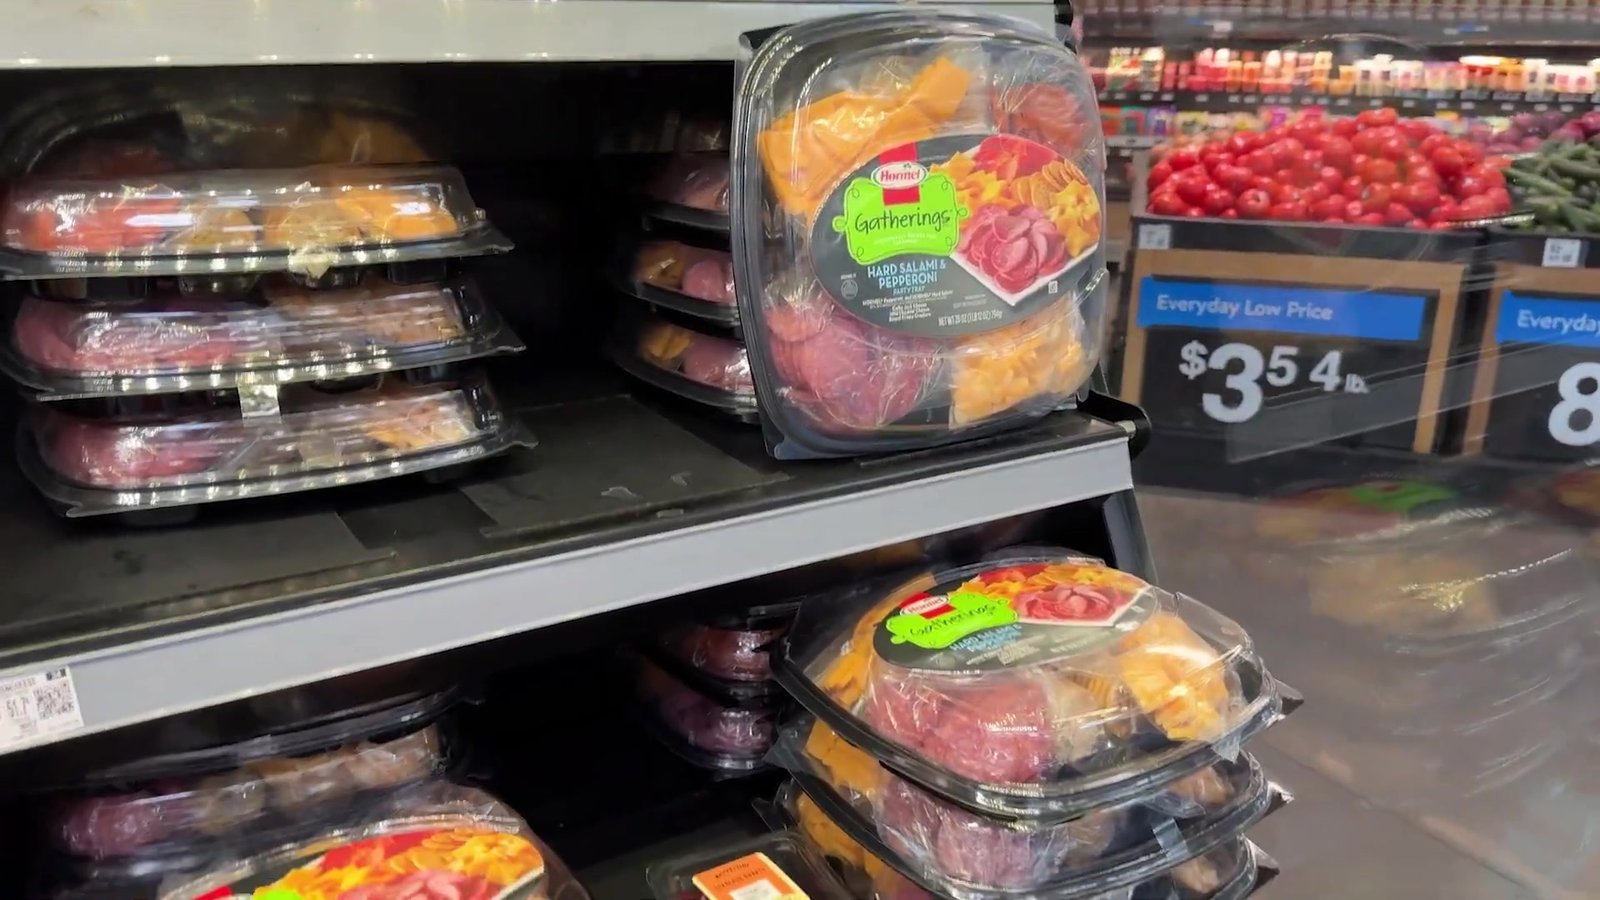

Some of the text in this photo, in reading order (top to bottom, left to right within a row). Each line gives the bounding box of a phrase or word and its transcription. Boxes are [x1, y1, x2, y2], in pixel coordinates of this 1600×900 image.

[880, 170, 920, 182] Hormel
[855, 207, 951, 235] Gatherings
[867, 264, 897, 278] HARD
[900, 259, 937, 273] SALAMI
[940, 259, 946, 269] &
[879, 271, 937, 289] PEPPERONI
[1157, 294, 1334, 320] Everyday Low Price
